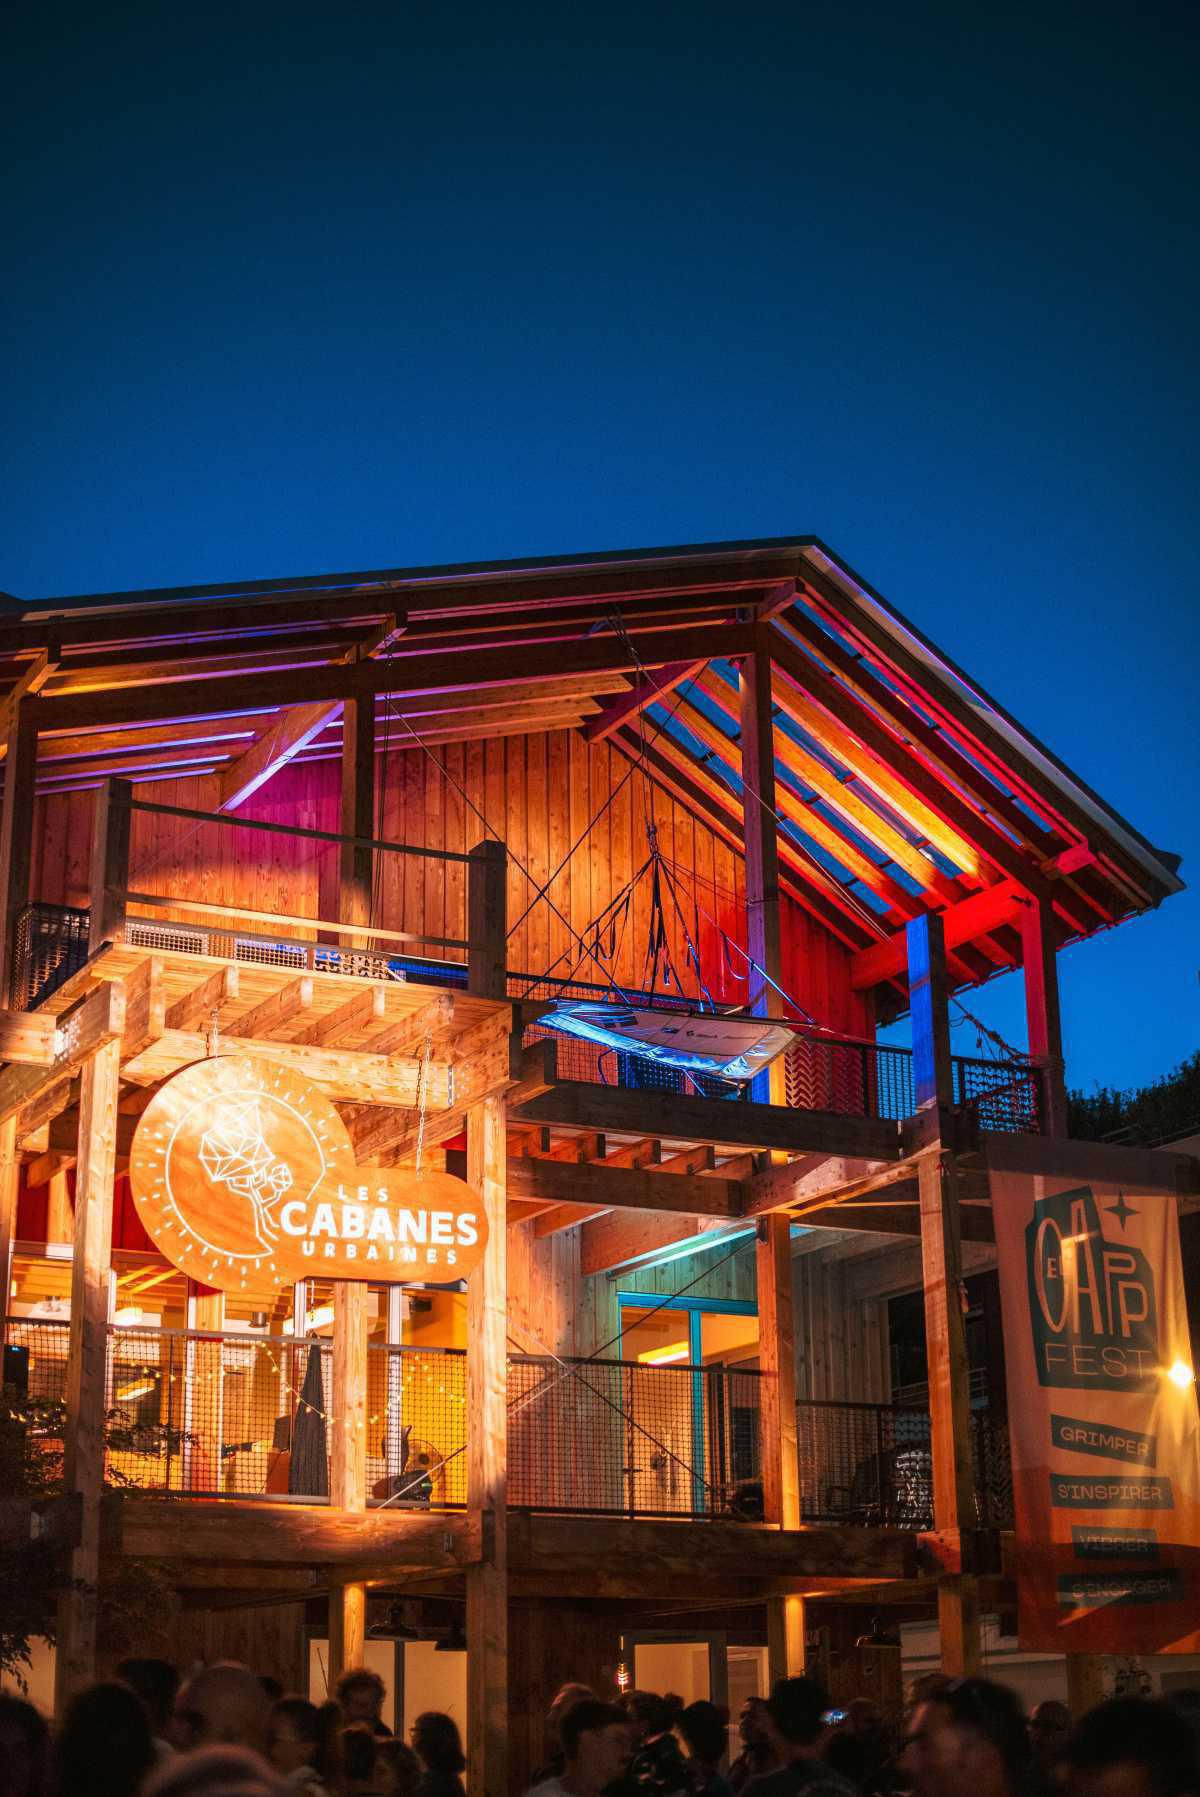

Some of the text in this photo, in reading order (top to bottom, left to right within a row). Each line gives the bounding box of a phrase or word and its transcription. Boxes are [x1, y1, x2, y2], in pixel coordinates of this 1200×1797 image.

[337, 1184, 389, 1203] LES
[280, 1201, 479, 1247] CABANES
[302, 1240, 457, 1265] URBAINES
[1045, 1343, 1153, 1378] FEST
[1059, 1427, 1149, 1456] GRIMPER
[1057, 1484, 1163, 1501] S'INSPIRER
[1079, 1534, 1150, 1552] VIBRER
